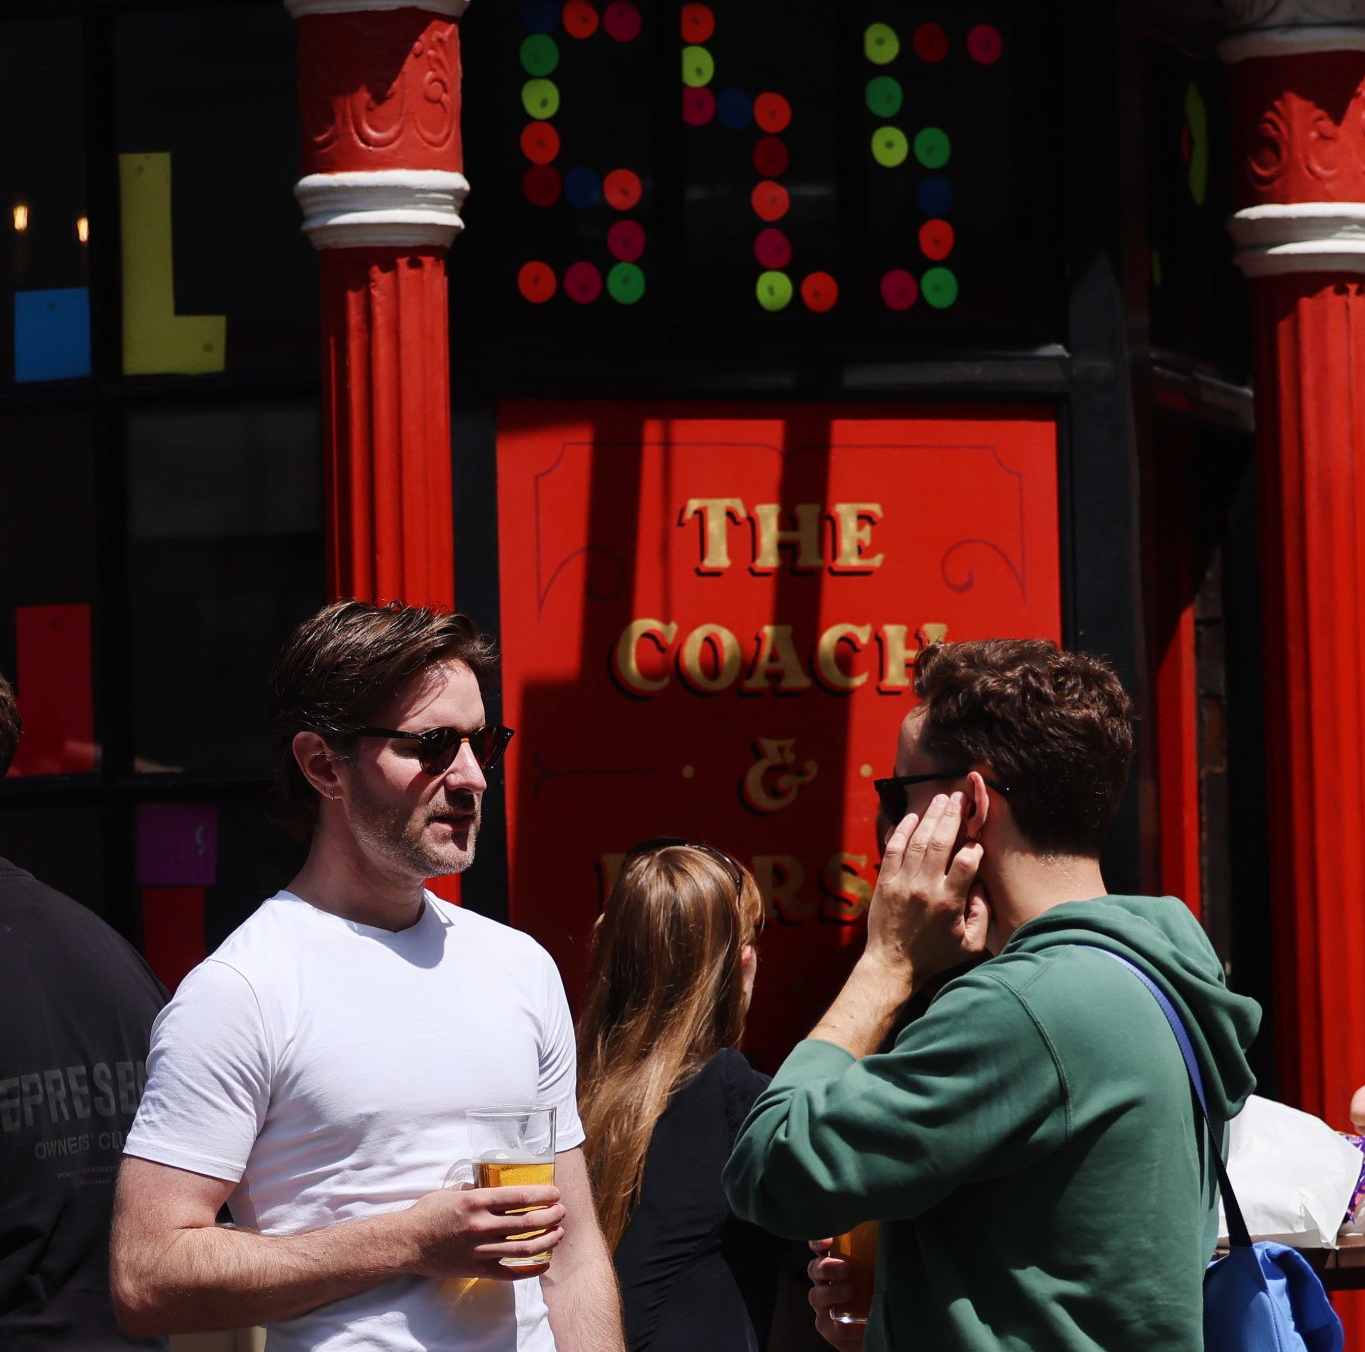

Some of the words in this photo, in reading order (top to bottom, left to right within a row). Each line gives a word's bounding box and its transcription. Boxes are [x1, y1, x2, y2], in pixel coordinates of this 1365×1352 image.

[680, 497, 886, 574] THE
[612, 618, 949, 697] COACH
[740, 738, 818, 814] &
